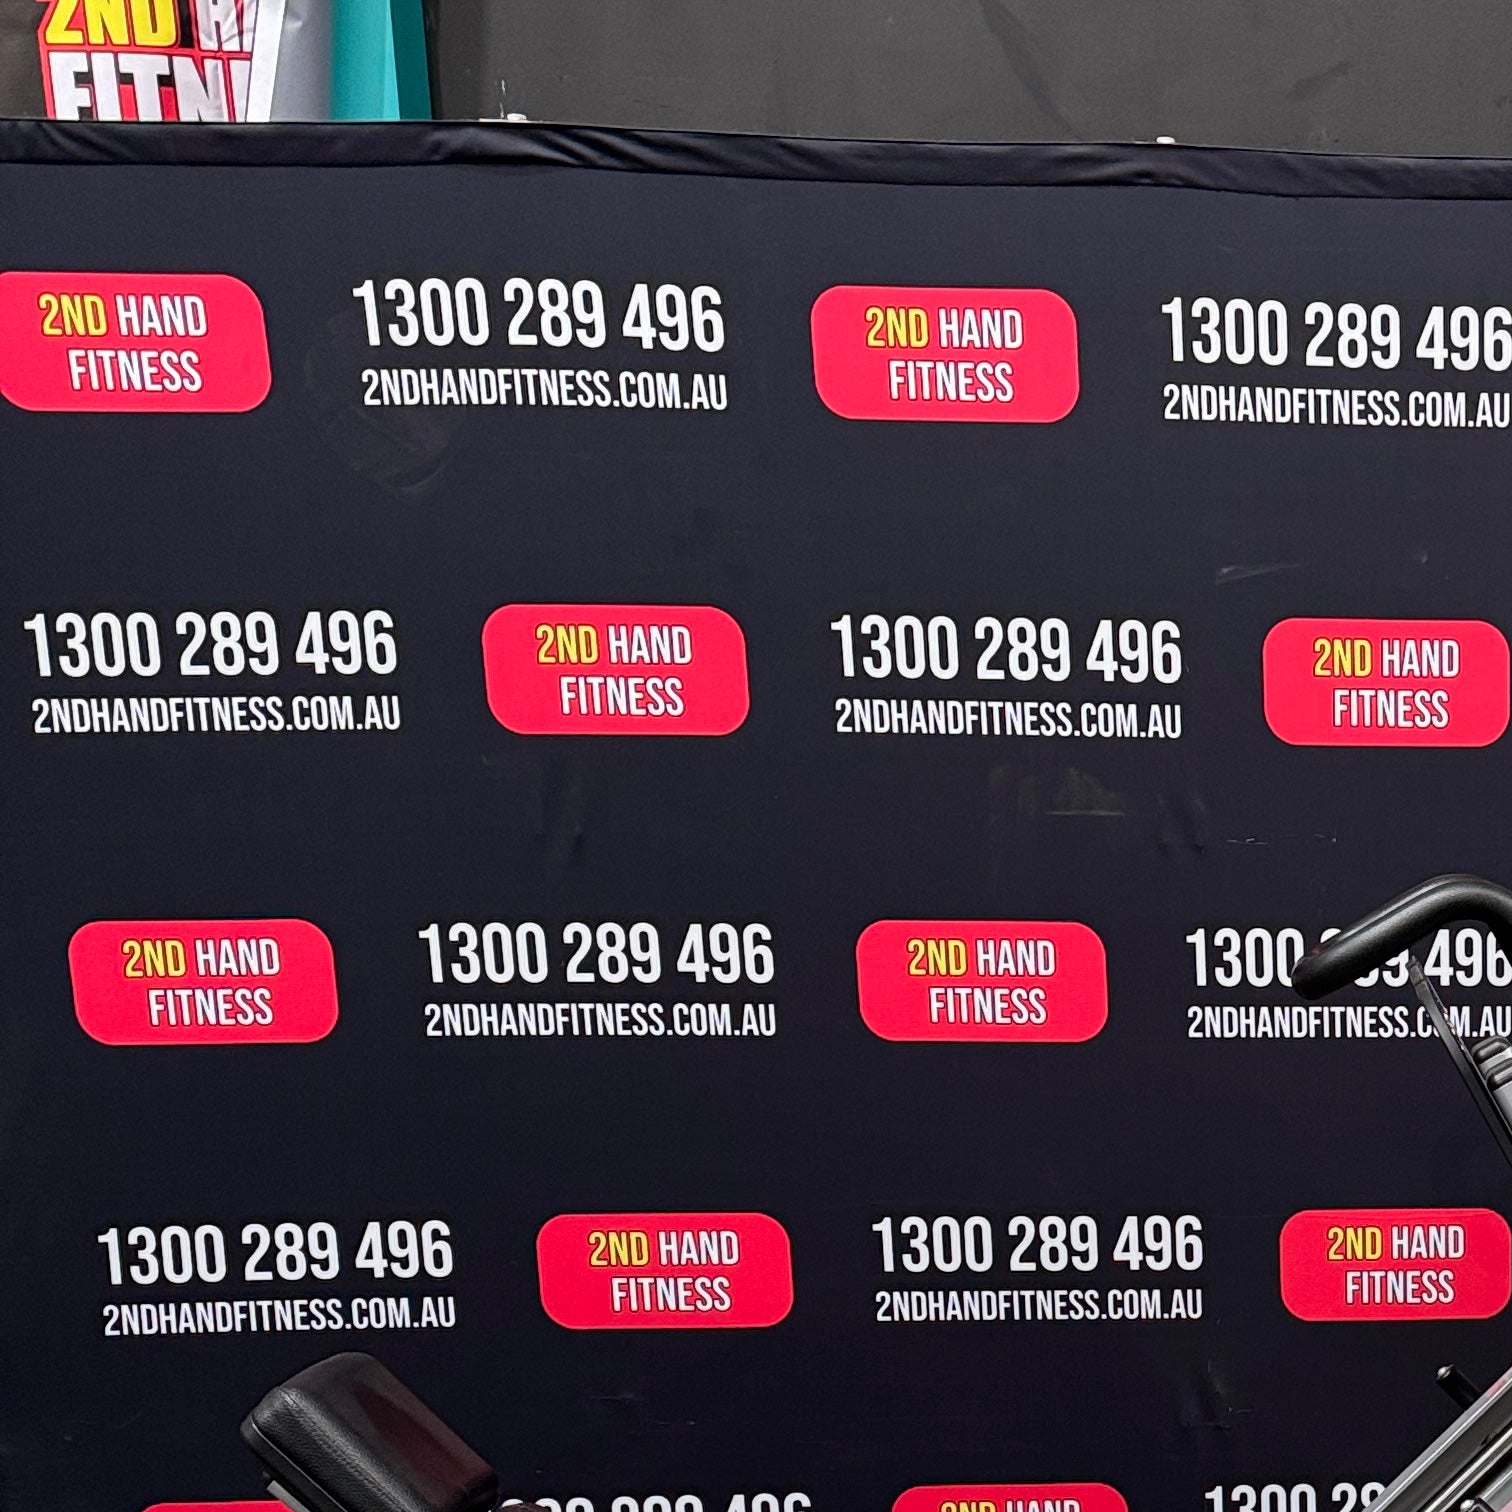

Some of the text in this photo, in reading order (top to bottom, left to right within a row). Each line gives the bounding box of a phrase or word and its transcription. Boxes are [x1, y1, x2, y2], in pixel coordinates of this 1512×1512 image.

[46, 0, 176, 46] 2ND
[40, 294, 206, 336] 2ND HAND
[353, 278, 724, 352] 1300 289 496
[866, 307, 1022, 348] 2ND HAND
[1162, 297, 1512, 371] 1300 289 496
[69, 350, 201, 391] FITNESS
[362, 369, 727, 410] 2NDHANDFITNESS.COM.AU
[890, 361, 1013, 401] FITNESS
[1164, 384, 1510, 427] 2NDHANDFITNESS.COM.AU
[24, 610, 396, 677] 1300 289 496
[537, 625, 691, 663] 2ND HAND
[831, 615, 1181, 683] 1300 289 496
[1315, 639, 1458, 677] 2ND HAND
[32, 696, 400, 733] 2NDHANDFITNESS.COM.AU
[561, 677, 683, 715] FITNESS
[1335, 690, 1448, 727] FITNESS
[836, 698, 1181, 738] 2NDHANDFITNESS.COM.AU
[123, 939, 279, 977] 2ND HAND
[419, 922, 774, 983] 1300 289 496
[908, 940, 1055, 975] 2ND HAND
[1186, 928, 1305, 987] 1300
[149, 988, 272, 1025] FITNESS
[425, 1003, 775, 1036] 2NDHANDFITNESS.COM.AU
[930, 988, 1046, 1023] FITNESS
[1187, 1006, 1512, 1039] 2NDHANDFITNESS.CM.AU
[98, 1220, 453, 1284] 1300 289 496
[589, 1231, 738, 1265] 2ND HAND
[872, 1215, 1203, 1272] 1300 289 496
[1328, 1226, 1464, 1259] 2ND HAND
[612, 1277, 730, 1311] FITNESS
[876, 1289, 1202, 1321] 2NDHANDFITNESS.COM.AU
[1347, 1270, 1454, 1303] FITNESS
[103, 1297, 455, 1336] 2NDHANDFITNESS.COM.AU
